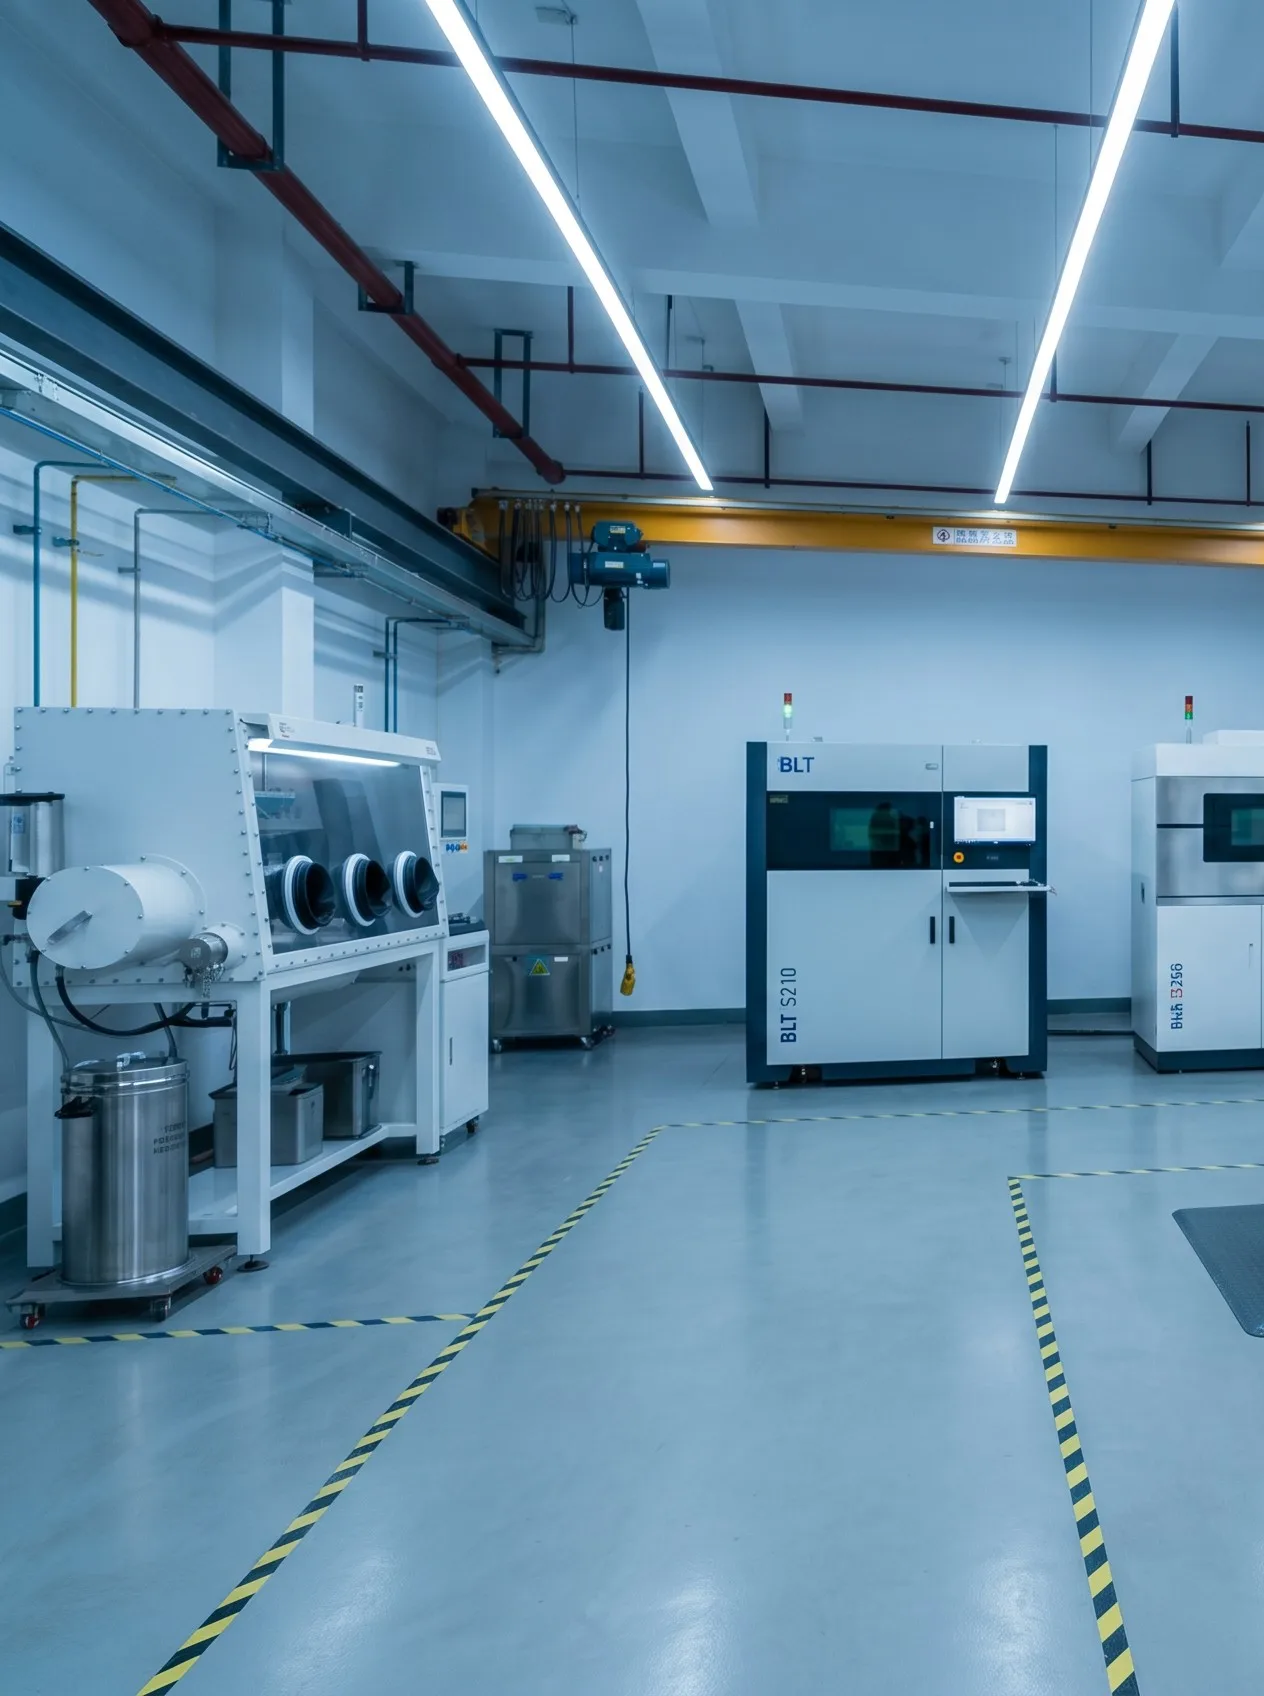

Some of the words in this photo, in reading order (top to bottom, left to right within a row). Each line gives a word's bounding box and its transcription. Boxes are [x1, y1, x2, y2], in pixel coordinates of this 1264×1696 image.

[779, 756, 815, 773] BLT
[780, 967, 797, 1007] S210
[780, 1013, 797, 1043] BLT
